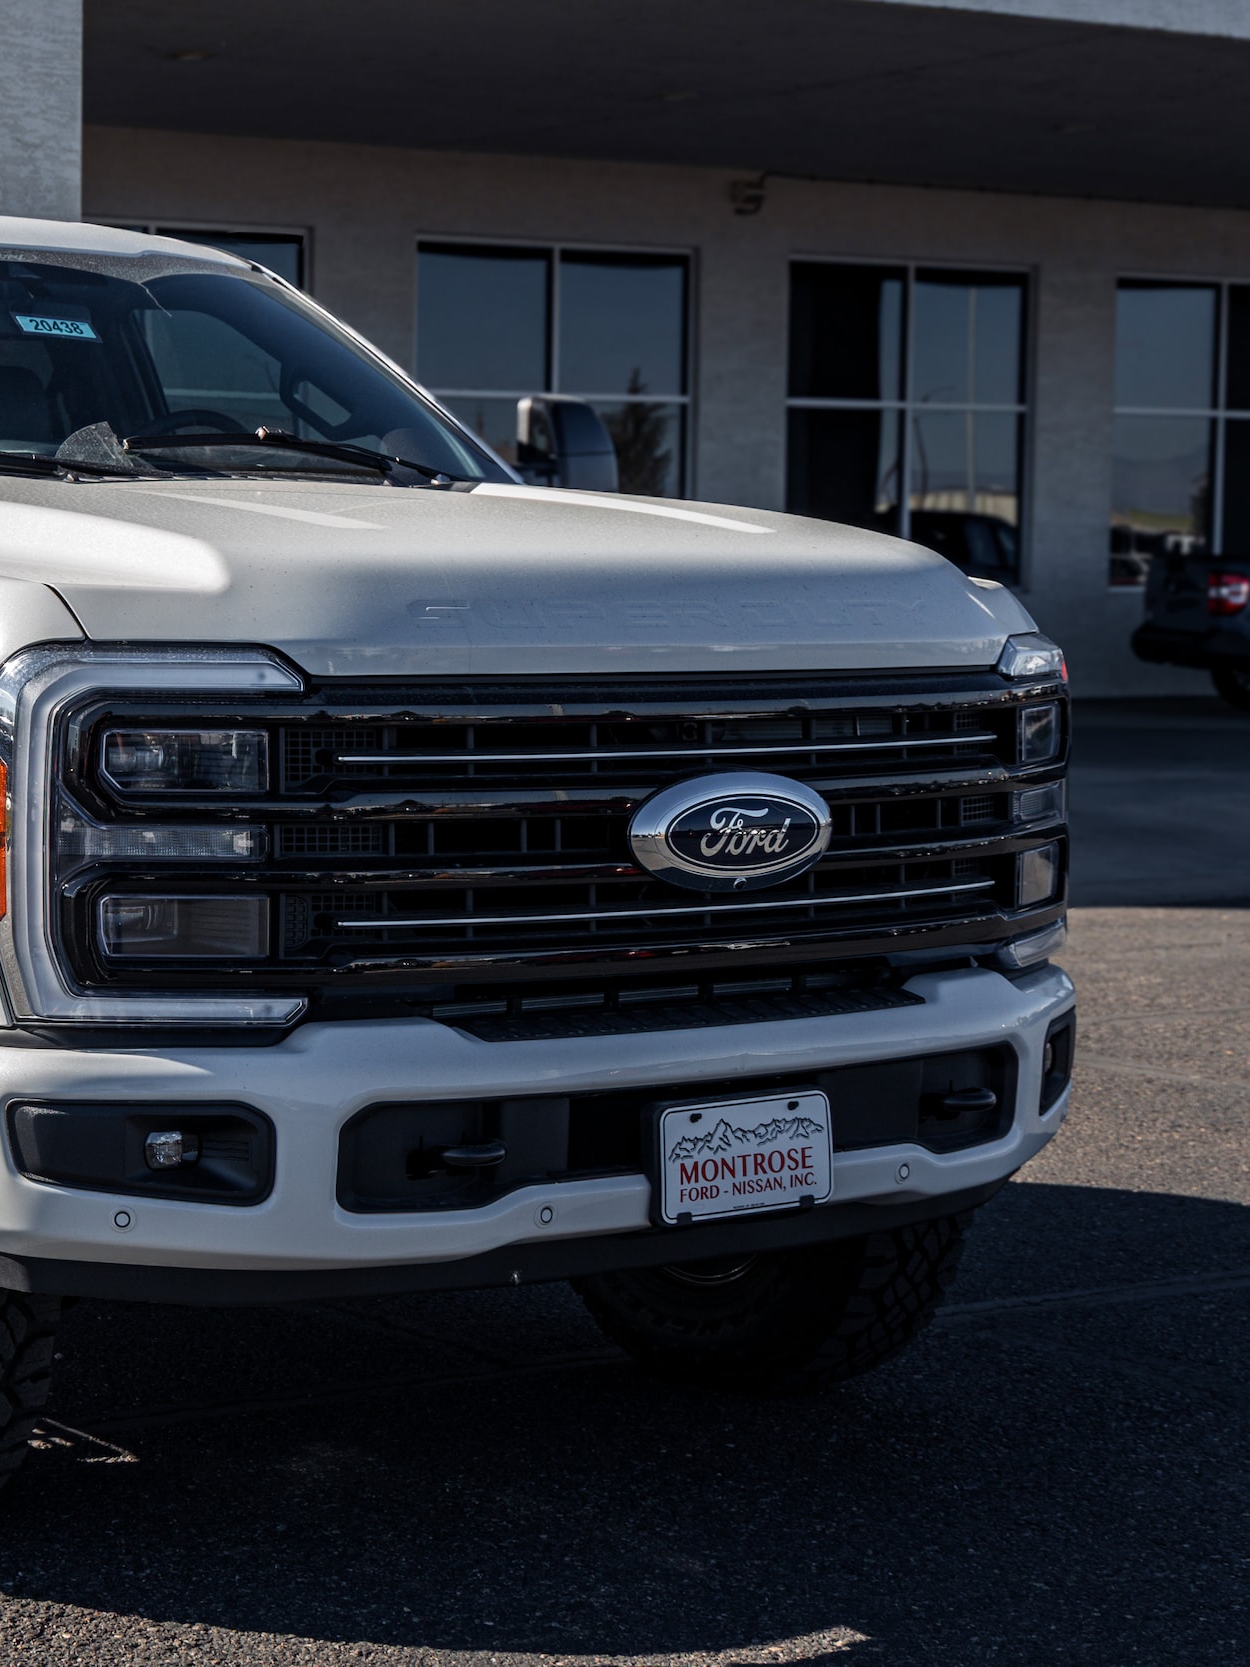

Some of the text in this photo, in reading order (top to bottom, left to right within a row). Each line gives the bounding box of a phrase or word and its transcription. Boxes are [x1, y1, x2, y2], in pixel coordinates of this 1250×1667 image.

[29, 318, 84, 335] 20438
[406, 599, 930, 629] SUPER DUTY
[700, 807, 792, 857] Ford
[679, 1146, 814, 1186] MONTROSE
[680, 1184, 720, 1203] FORD
[732, 1175, 787, 1197] NISSAN,
[790, 1172, 817, 1189] INC.
